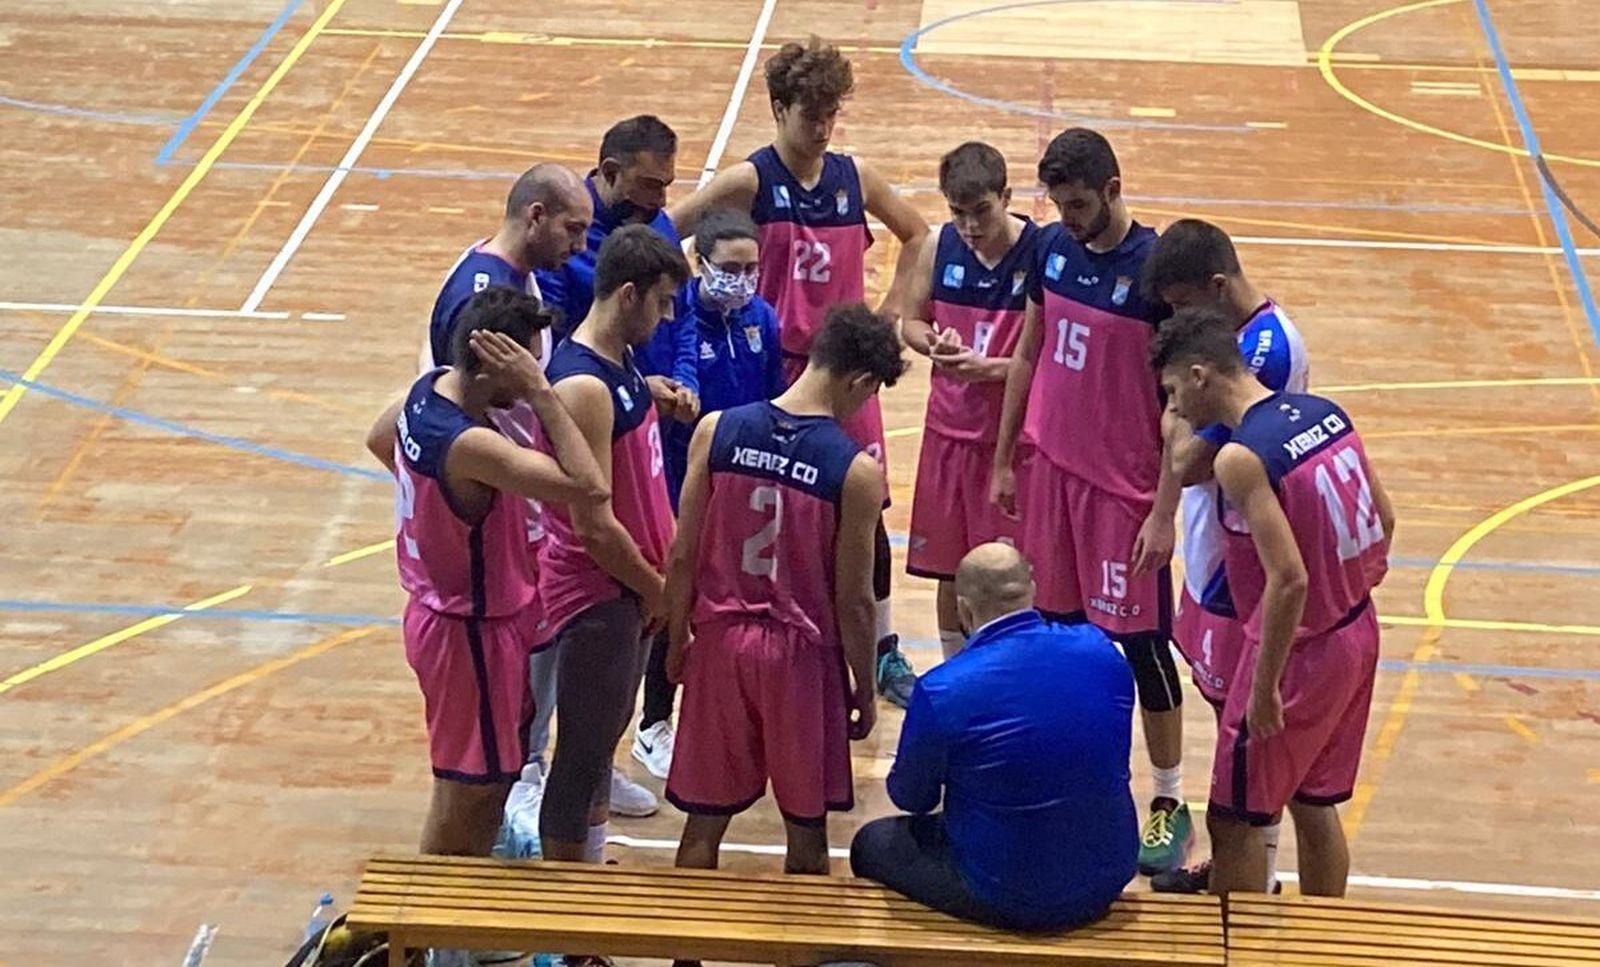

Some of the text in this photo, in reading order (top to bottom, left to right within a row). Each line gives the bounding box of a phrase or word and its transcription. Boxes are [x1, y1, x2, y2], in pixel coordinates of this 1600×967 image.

[793, 240, 831, 283] 22
[1053, 318, 1090, 372] 15
[791, 461, 819, 486] CD
[1315, 446, 1385, 566] 12
[741, 486, 783, 583] 2
[1102, 560, 1127, 599] 15
